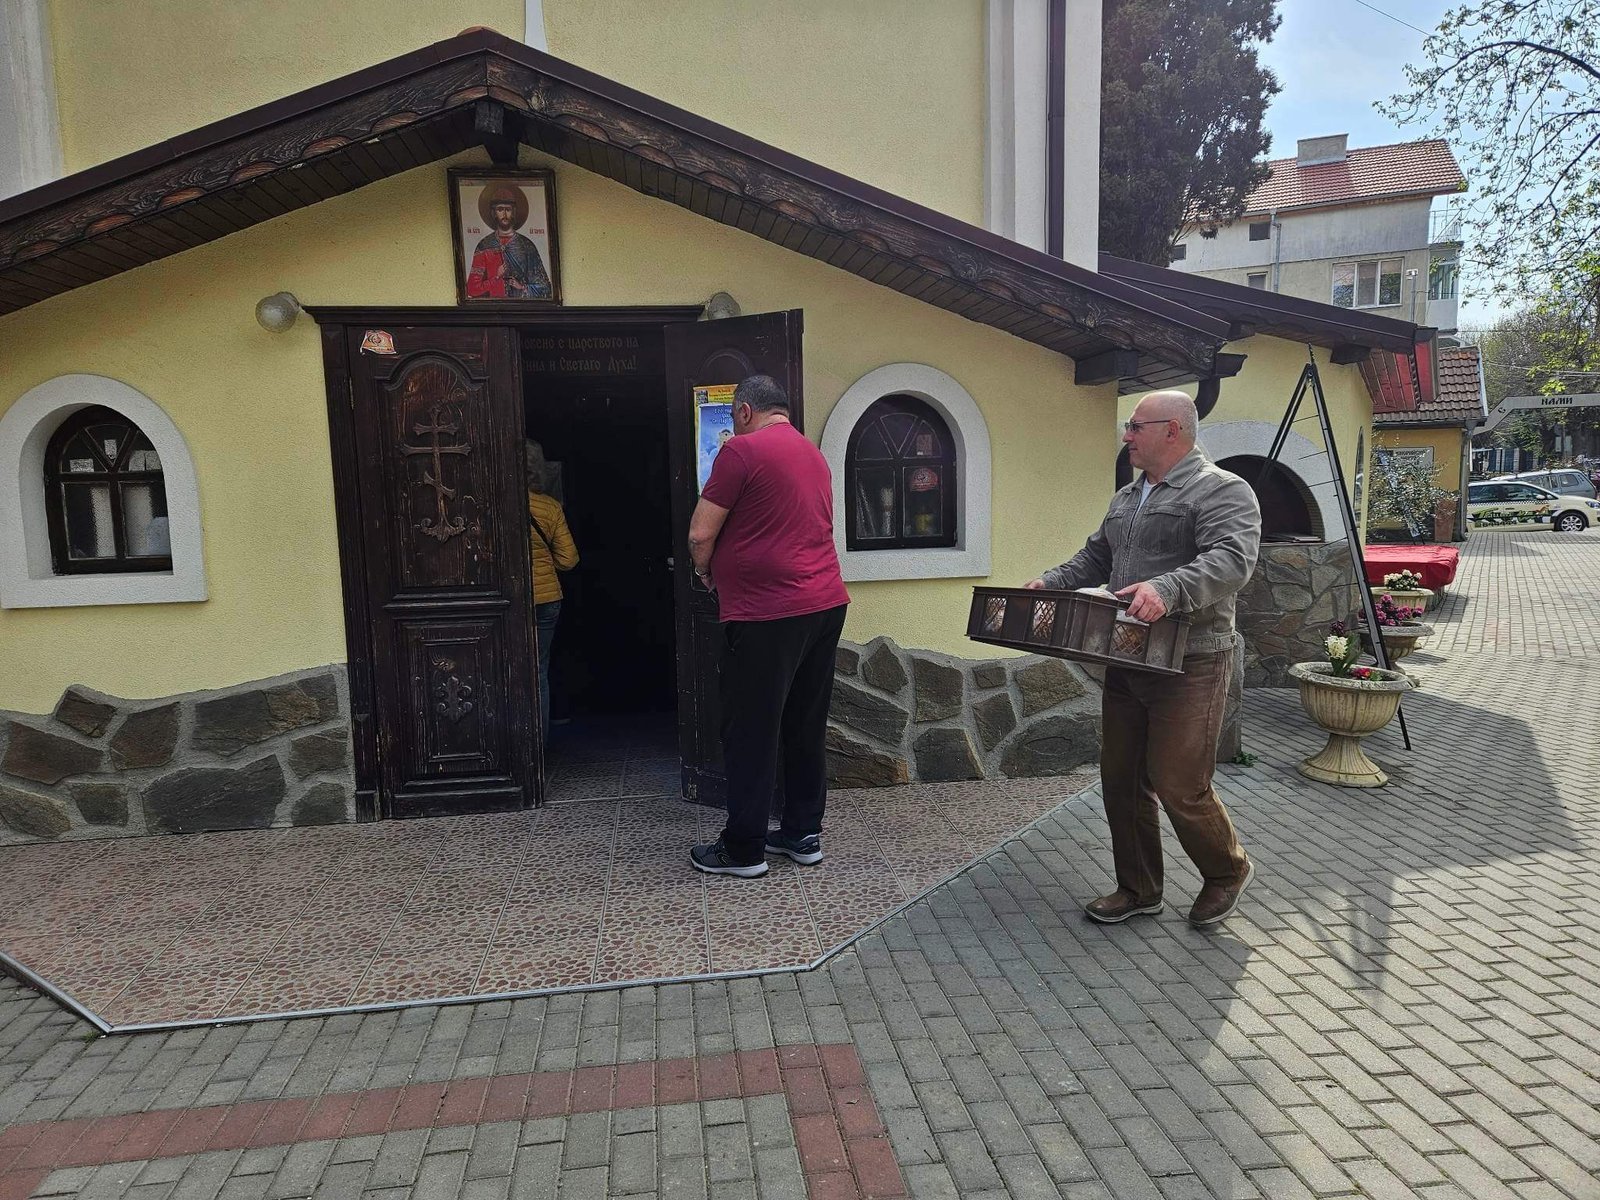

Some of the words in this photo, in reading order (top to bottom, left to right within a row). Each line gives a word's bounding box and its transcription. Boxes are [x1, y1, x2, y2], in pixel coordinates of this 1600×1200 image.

[568, 337, 622, 352] царството
[559, 357, 601, 372] Светаго
[608, 354, 637, 374] Духа!
